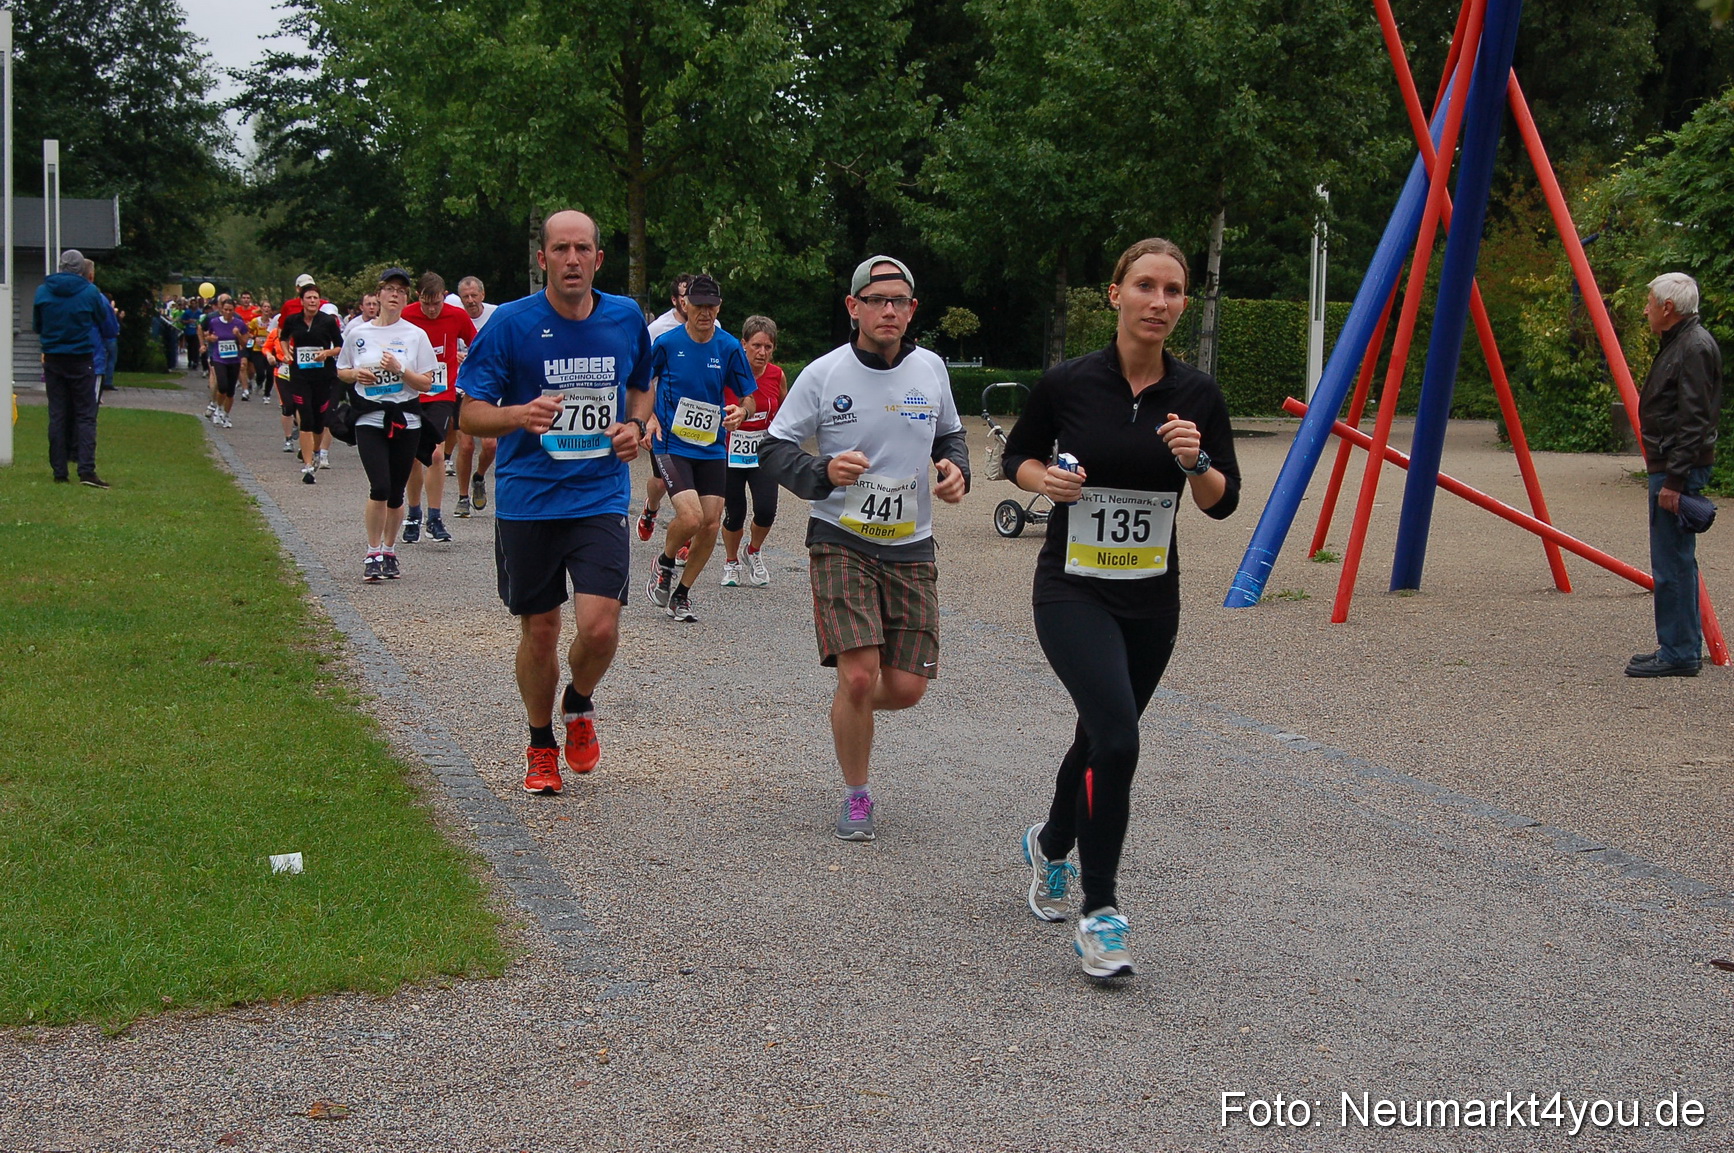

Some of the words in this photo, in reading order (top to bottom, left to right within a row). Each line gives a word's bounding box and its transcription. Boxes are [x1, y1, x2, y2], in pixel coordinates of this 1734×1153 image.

[220, 344, 236, 352] 2941
[544, 356, 616, 376] HUBER
[374, 370, 400, 385] 535
[559, 373, 614, 382] TECHNOLOGY
[558, 381, 575, 389] WASTE
[569, 394, 606, 402] Neumarkt
[549, 404, 611, 431] 2768
[684, 409, 713, 430] 563
[832, 412, 858, 421] PARTL
[557, 436, 600, 449] Willibald
[733, 439, 761, 454] 230
[853, 479, 875, 490] ARTL
[876, 483, 909, 493] Neumarkt
[1079, 493, 1106, 503] ARTL
[860, 493, 903, 522] 441
[860, 523, 896, 537] Robert
[1090, 508, 1152, 543] 135
[1097, 551, 1139, 566] Nicole
